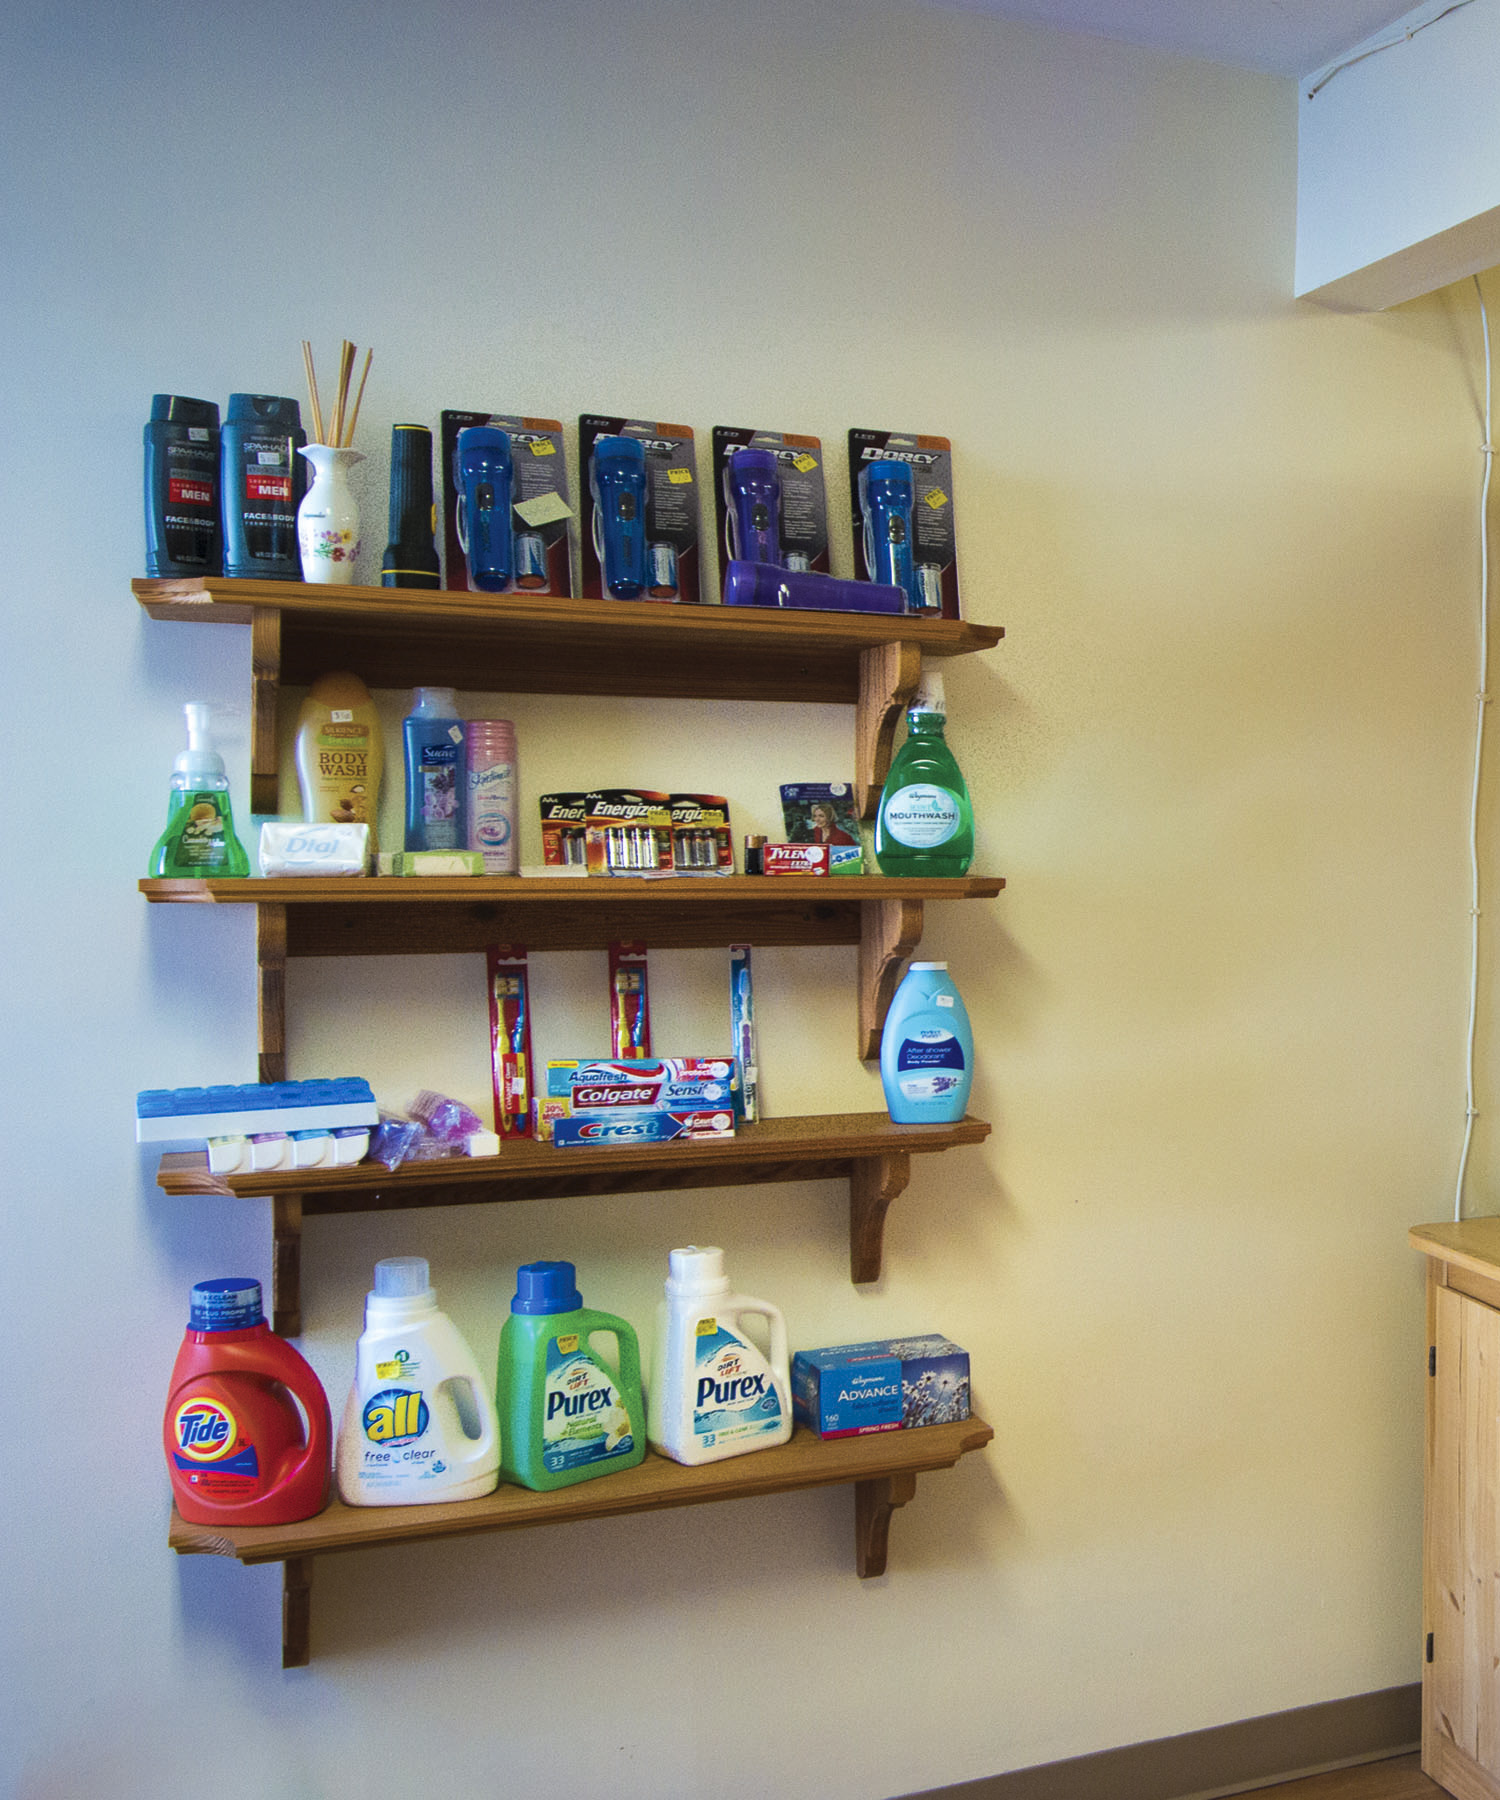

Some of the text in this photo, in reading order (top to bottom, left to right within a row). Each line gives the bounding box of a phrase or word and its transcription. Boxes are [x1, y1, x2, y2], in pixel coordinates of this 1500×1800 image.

[585, 418, 610, 426] LED
[854, 432, 876, 440] LED
[860, 447, 941, 464] DORCY
[181, 489, 210, 502] MEN
[258, 485, 289, 496] MEN
[320, 752, 368, 765] BODY
[423, 747, 455, 758] Suave
[320, 764, 368, 776] WASH
[890, 812, 955, 820] MOUTHWASH
[285, 838, 340, 853] Dial
[906, 1053, 945, 1061] Deodorant
[569, 1071, 628, 1083] Aquafresh
[577, 1087, 654, 1105] Colgate
[579, 1120, 660, 1138] Crest
[717, 1358, 740, 1371] DIRT
[720, 1365, 741, 1377] LIFT
[567, 1372, 588, 1385] DIRT
[569, 1379, 590, 1390] LIFT
[696, 1373, 766, 1408] Purex
[838, 1384, 899, 1402] ADVANCE
[547, 1386, 613, 1421] Purex
[367, 1391, 422, 1441] all
[825, 1414, 839, 1422] 160
[180, 1413, 229, 1449] Tide
[858, 1425, 880, 1434] SPRING
[703, 1433, 716, 1444] 33
[364, 1449, 436, 1461] free clear
[551, 1455, 565, 1466] 33
